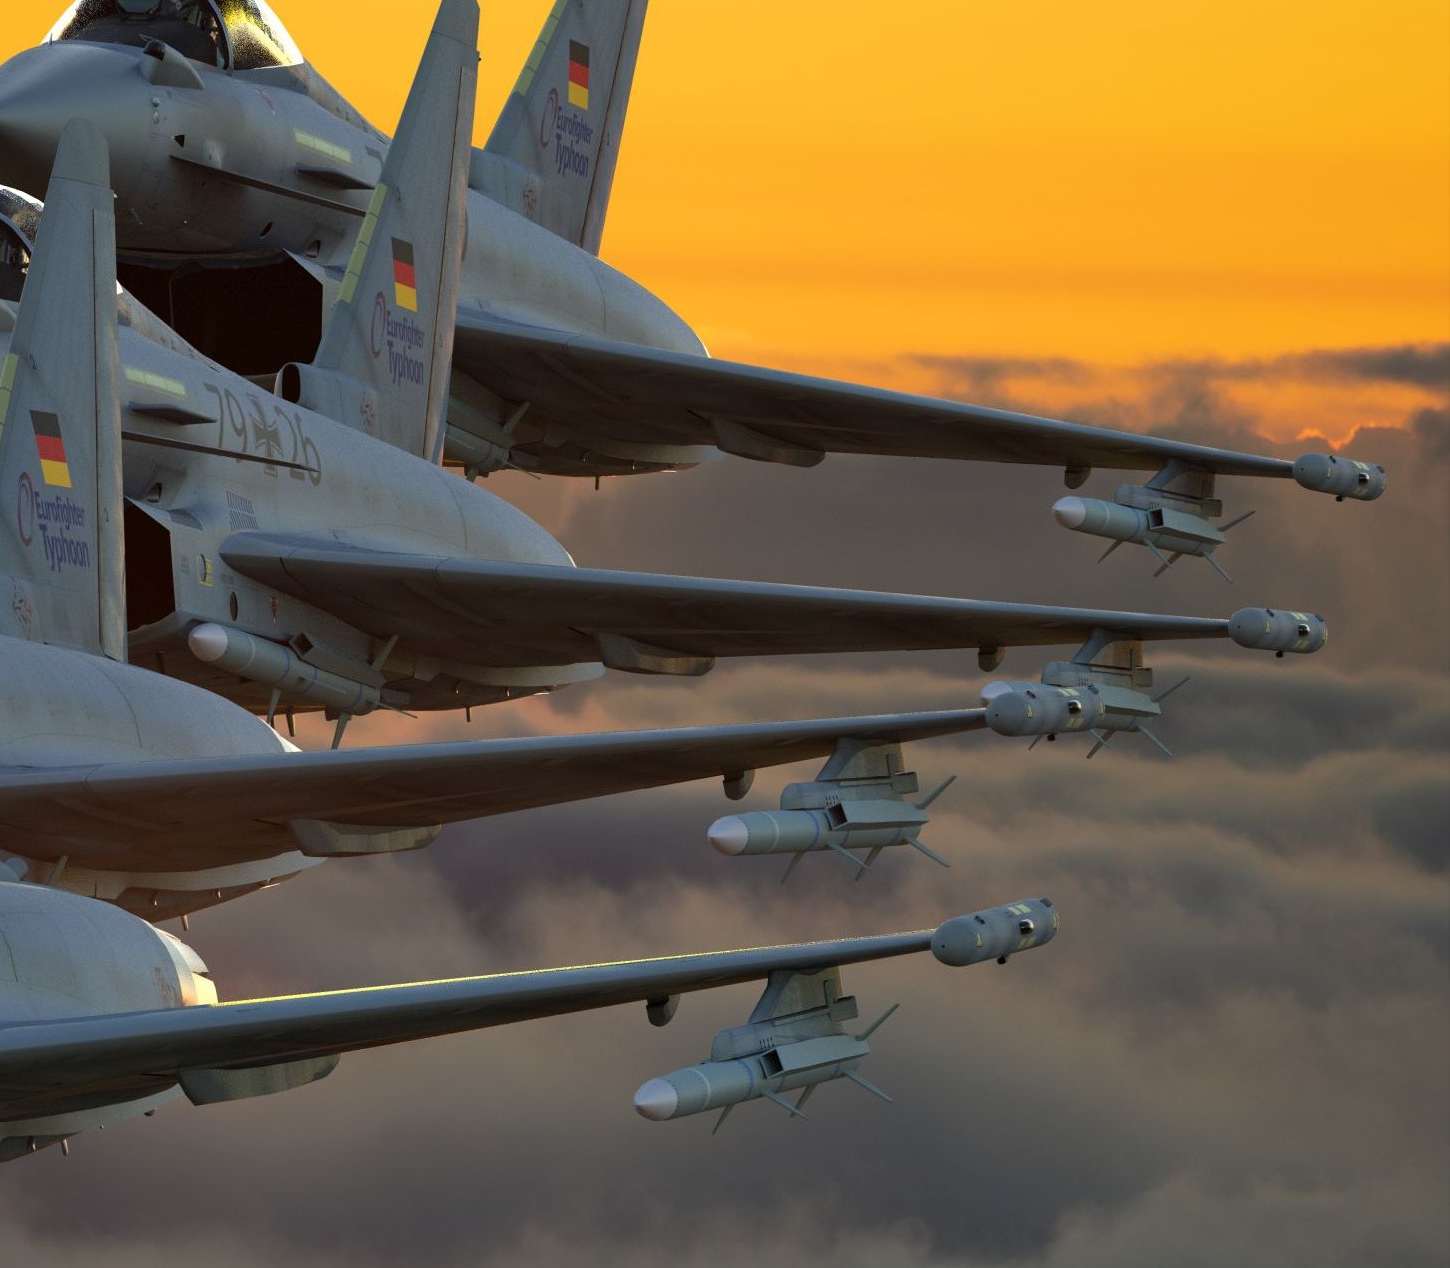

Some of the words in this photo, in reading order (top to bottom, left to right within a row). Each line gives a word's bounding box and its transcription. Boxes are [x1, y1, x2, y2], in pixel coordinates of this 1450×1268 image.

[556, 133, 589, 178] Typhoon
[386, 310, 425, 349] Eurofighter
[387, 339, 424, 387] Typhoon
[203, 381, 248, 463] 79
[274, 405, 321, 486] 26
[34, 490, 85, 530] Eurofighter
[38, 523, 90, 573] Typhoon
